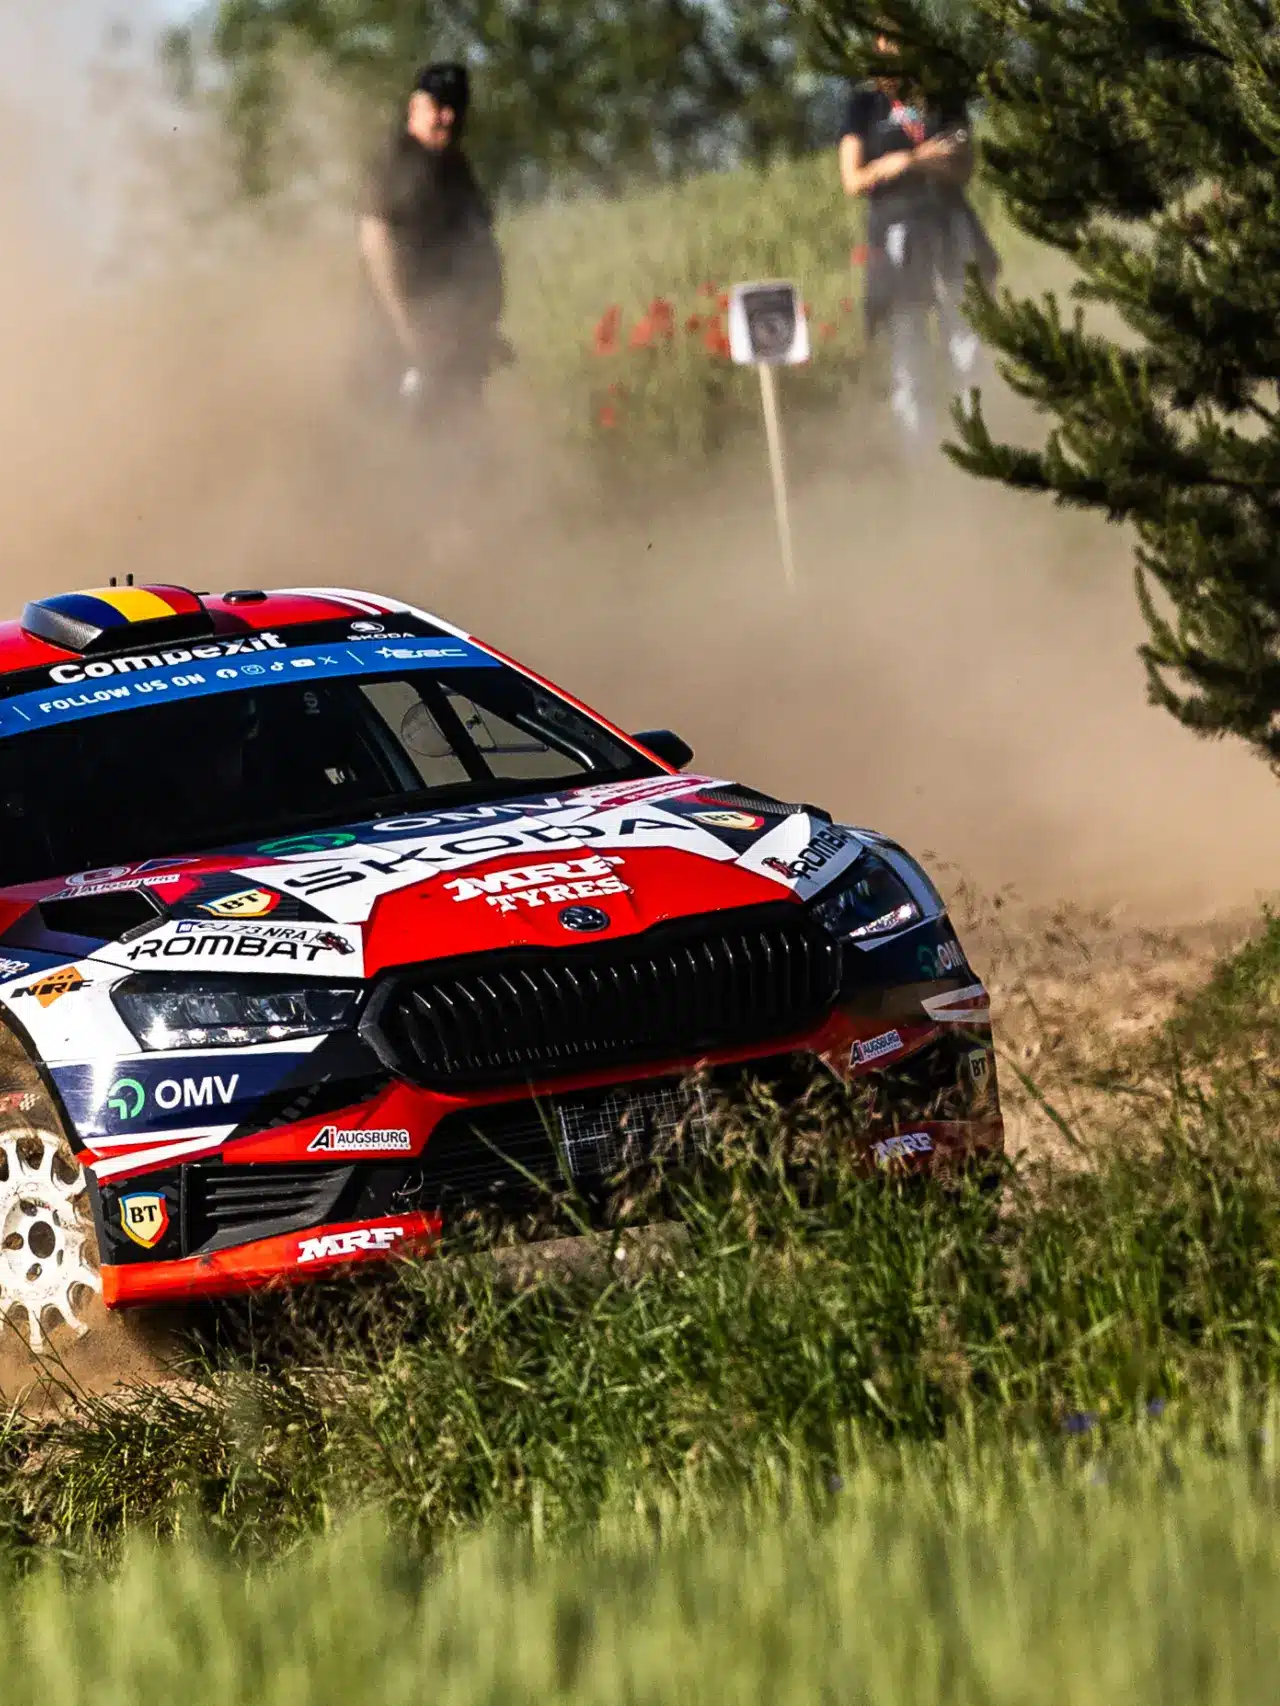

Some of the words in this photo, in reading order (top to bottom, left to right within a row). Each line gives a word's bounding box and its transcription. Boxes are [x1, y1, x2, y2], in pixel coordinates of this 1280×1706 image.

[347, 632, 416, 641] SKODA
[49, 632, 287, 684] Compexit
[39, 685, 131, 714] FOLLOW
[134, 679, 168, 694] US
[171, 673, 206, 687] ON
[372, 796, 564, 832] OMV
[283, 817, 697, 896] SKODA
[443, 854, 626, 903] MRF
[220, 892, 261, 911] BT
[486, 875, 634, 914] TYRES
[127, 934, 332, 961] ROMBAT
[262, 927, 308, 941] NRA
[10, 979, 94, 999] NRF
[863, 1031, 901, 1055] AUGSBURG
[971, 1058, 986, 1078] BT
[155, 1074, 239, 1110] OMV
[337, 1131, 408, 1144] AUGSBURG
[130, 1205, 158, 1224] BT
[297, 1226, 404, 1263] MRF
